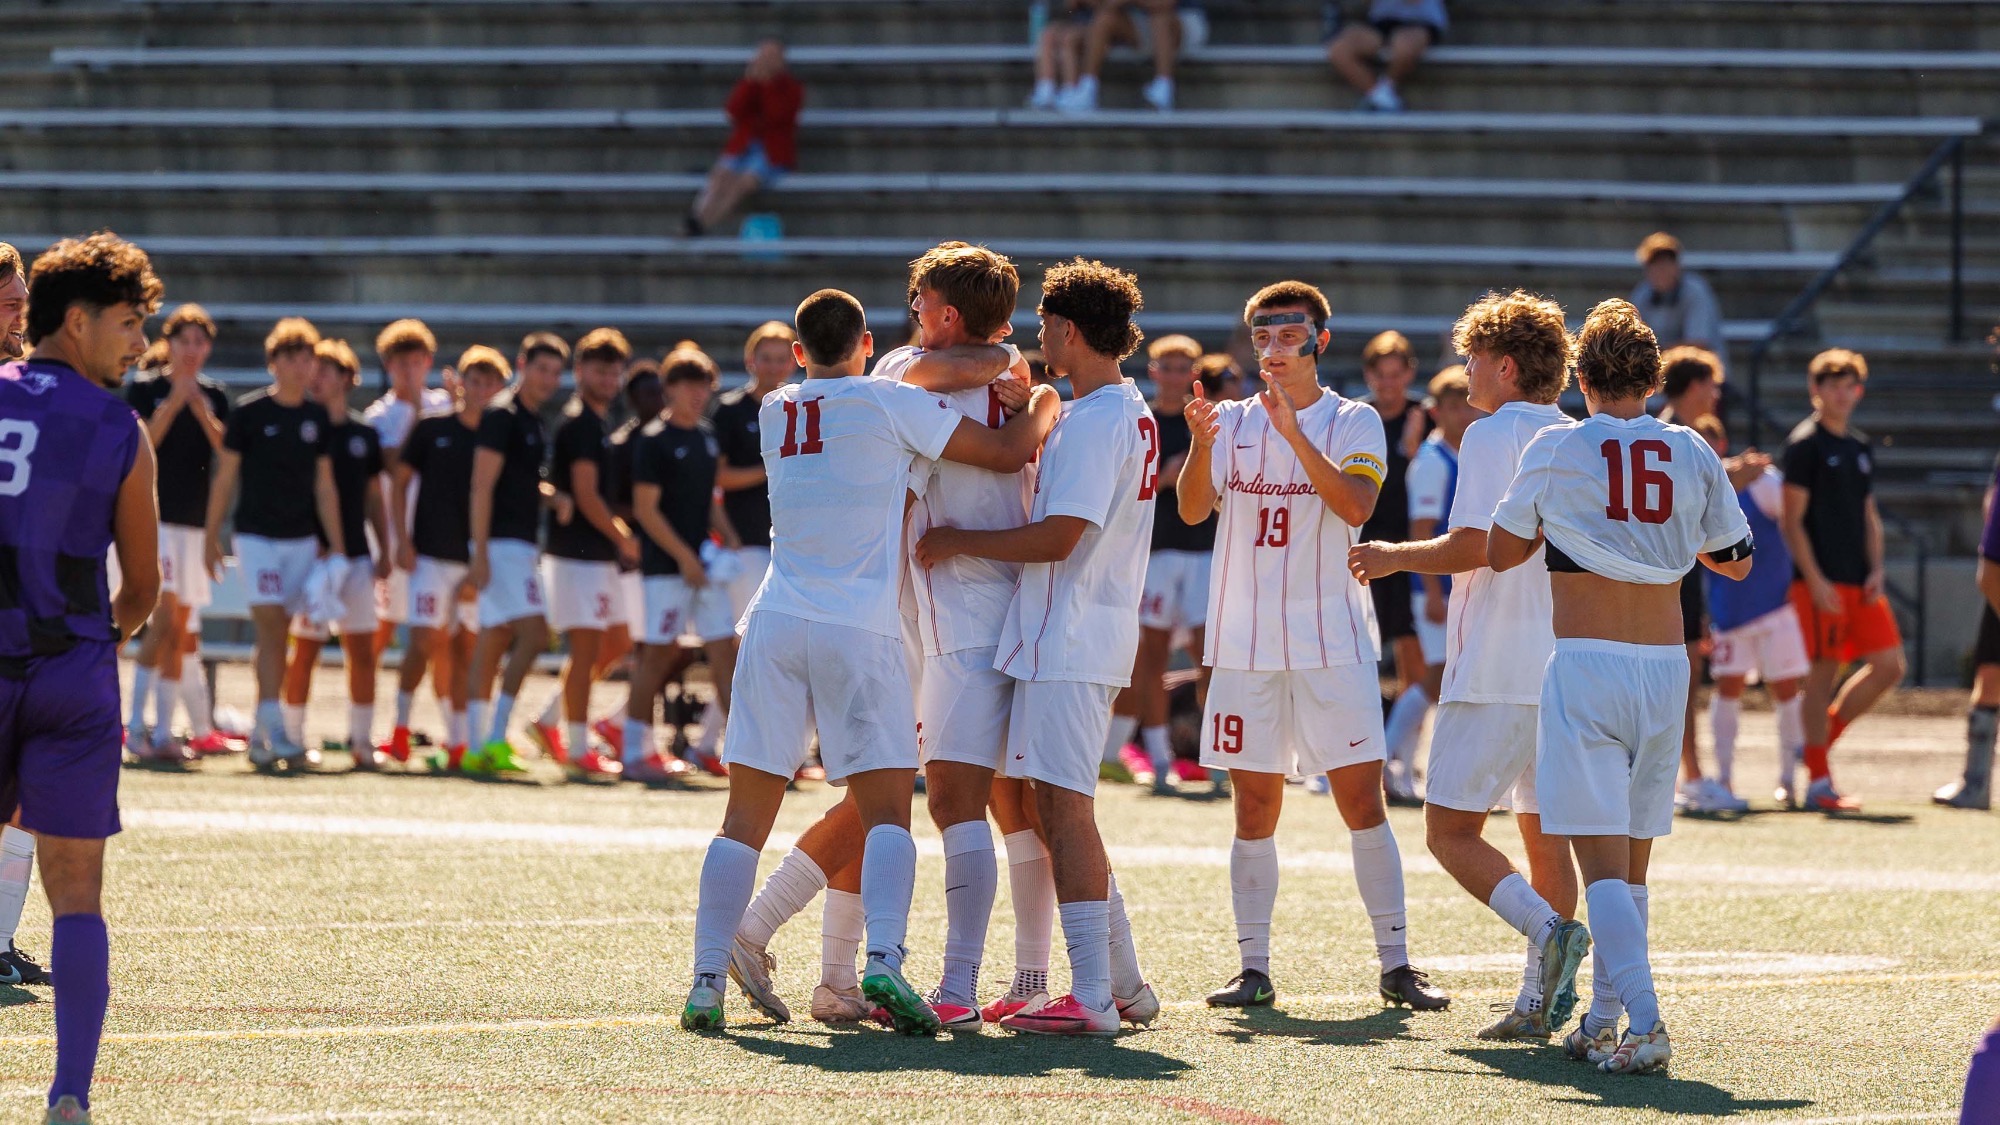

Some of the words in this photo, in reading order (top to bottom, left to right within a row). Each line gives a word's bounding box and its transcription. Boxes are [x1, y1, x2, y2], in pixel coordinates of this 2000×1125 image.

[780, 395, 825, 459] 11
[1600, 438, 1674, 525] 16
[1255, 506, 1289, 548] 19
[1213, 712, 1244, 754] 19
